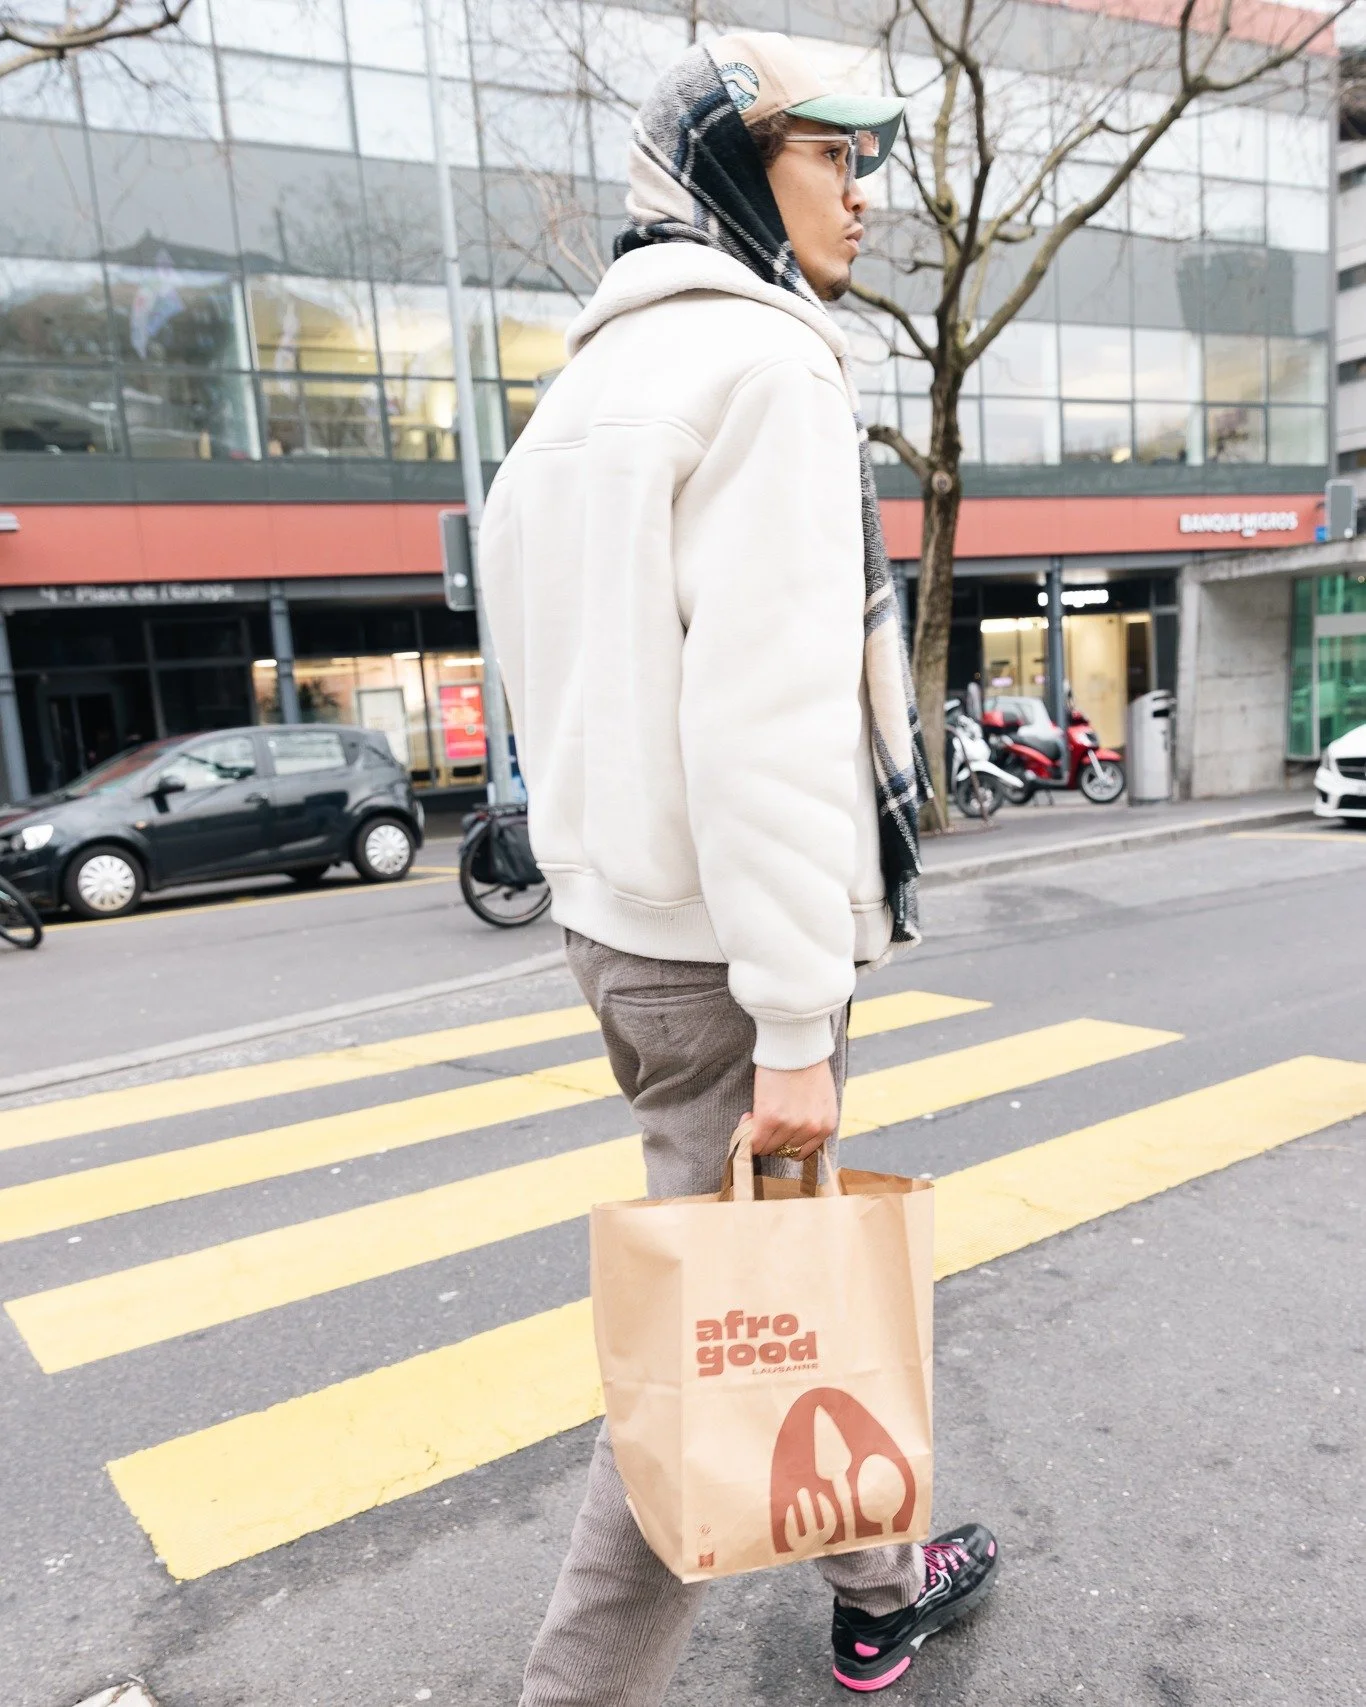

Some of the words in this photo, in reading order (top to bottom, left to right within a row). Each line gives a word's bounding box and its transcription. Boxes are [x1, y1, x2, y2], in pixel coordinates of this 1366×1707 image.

[696, 1310, 799, 1342] afro
[696, 1331, 818, 1377] good
[752, 1362, 819, 1375] LAUSANNE
